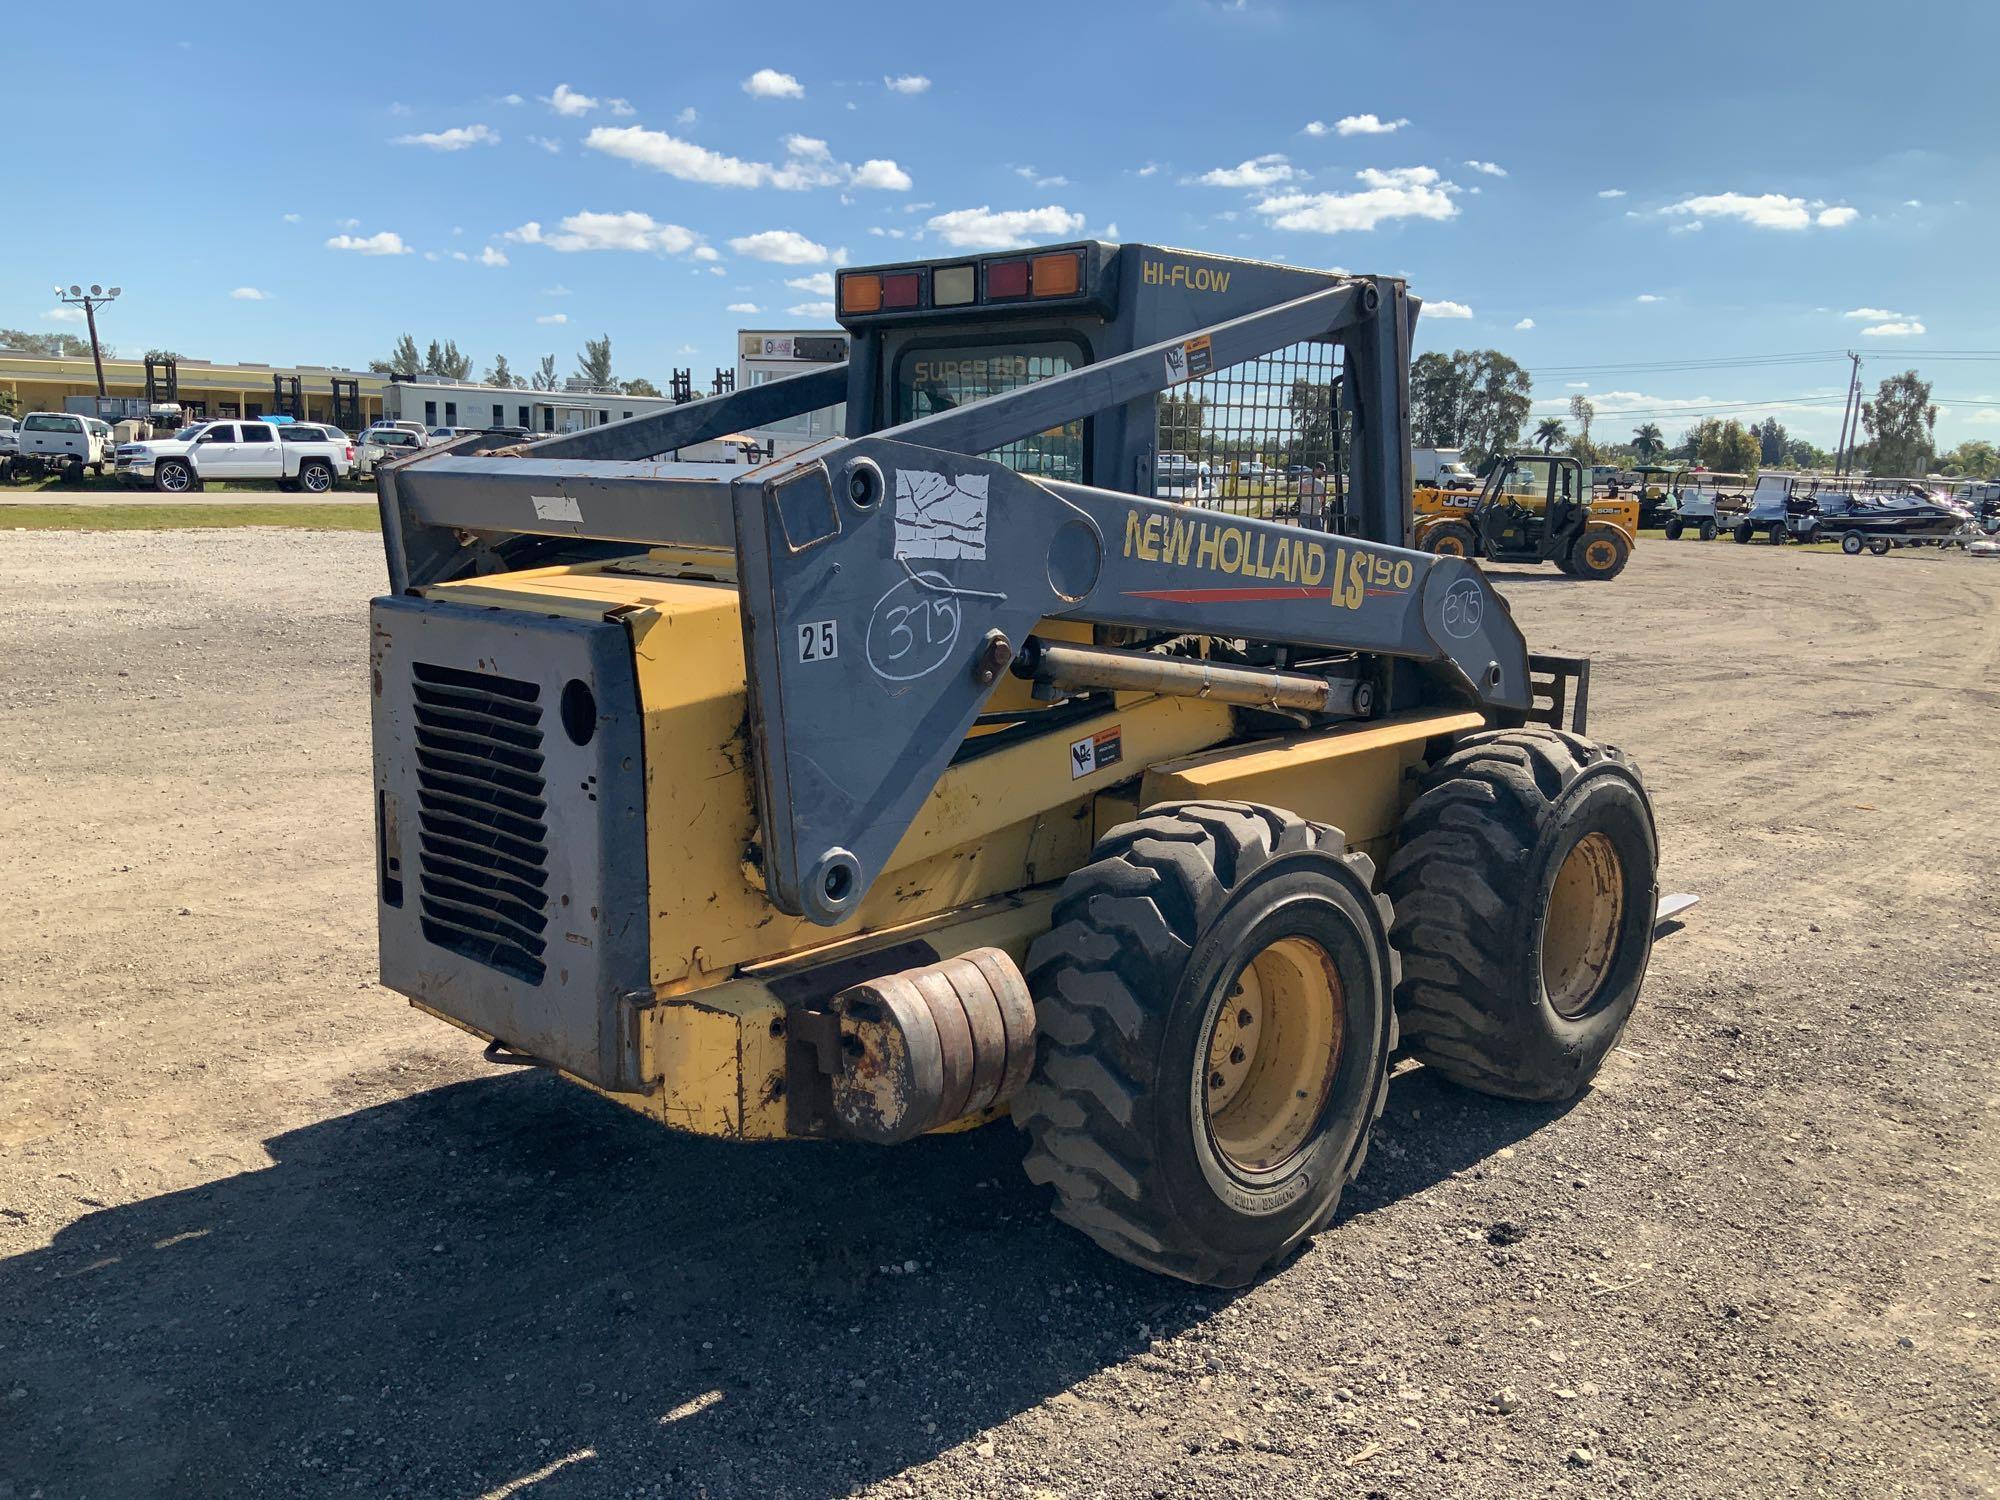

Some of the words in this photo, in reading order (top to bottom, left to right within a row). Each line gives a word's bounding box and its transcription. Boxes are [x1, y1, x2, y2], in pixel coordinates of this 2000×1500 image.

[1143, 261, 1231, 293] HI-FLOW
[1123, 509, 1195, 566] NEW
[1196, 523, 1326, 586] HOLLAND
[802, 623, 834, 660] 25
